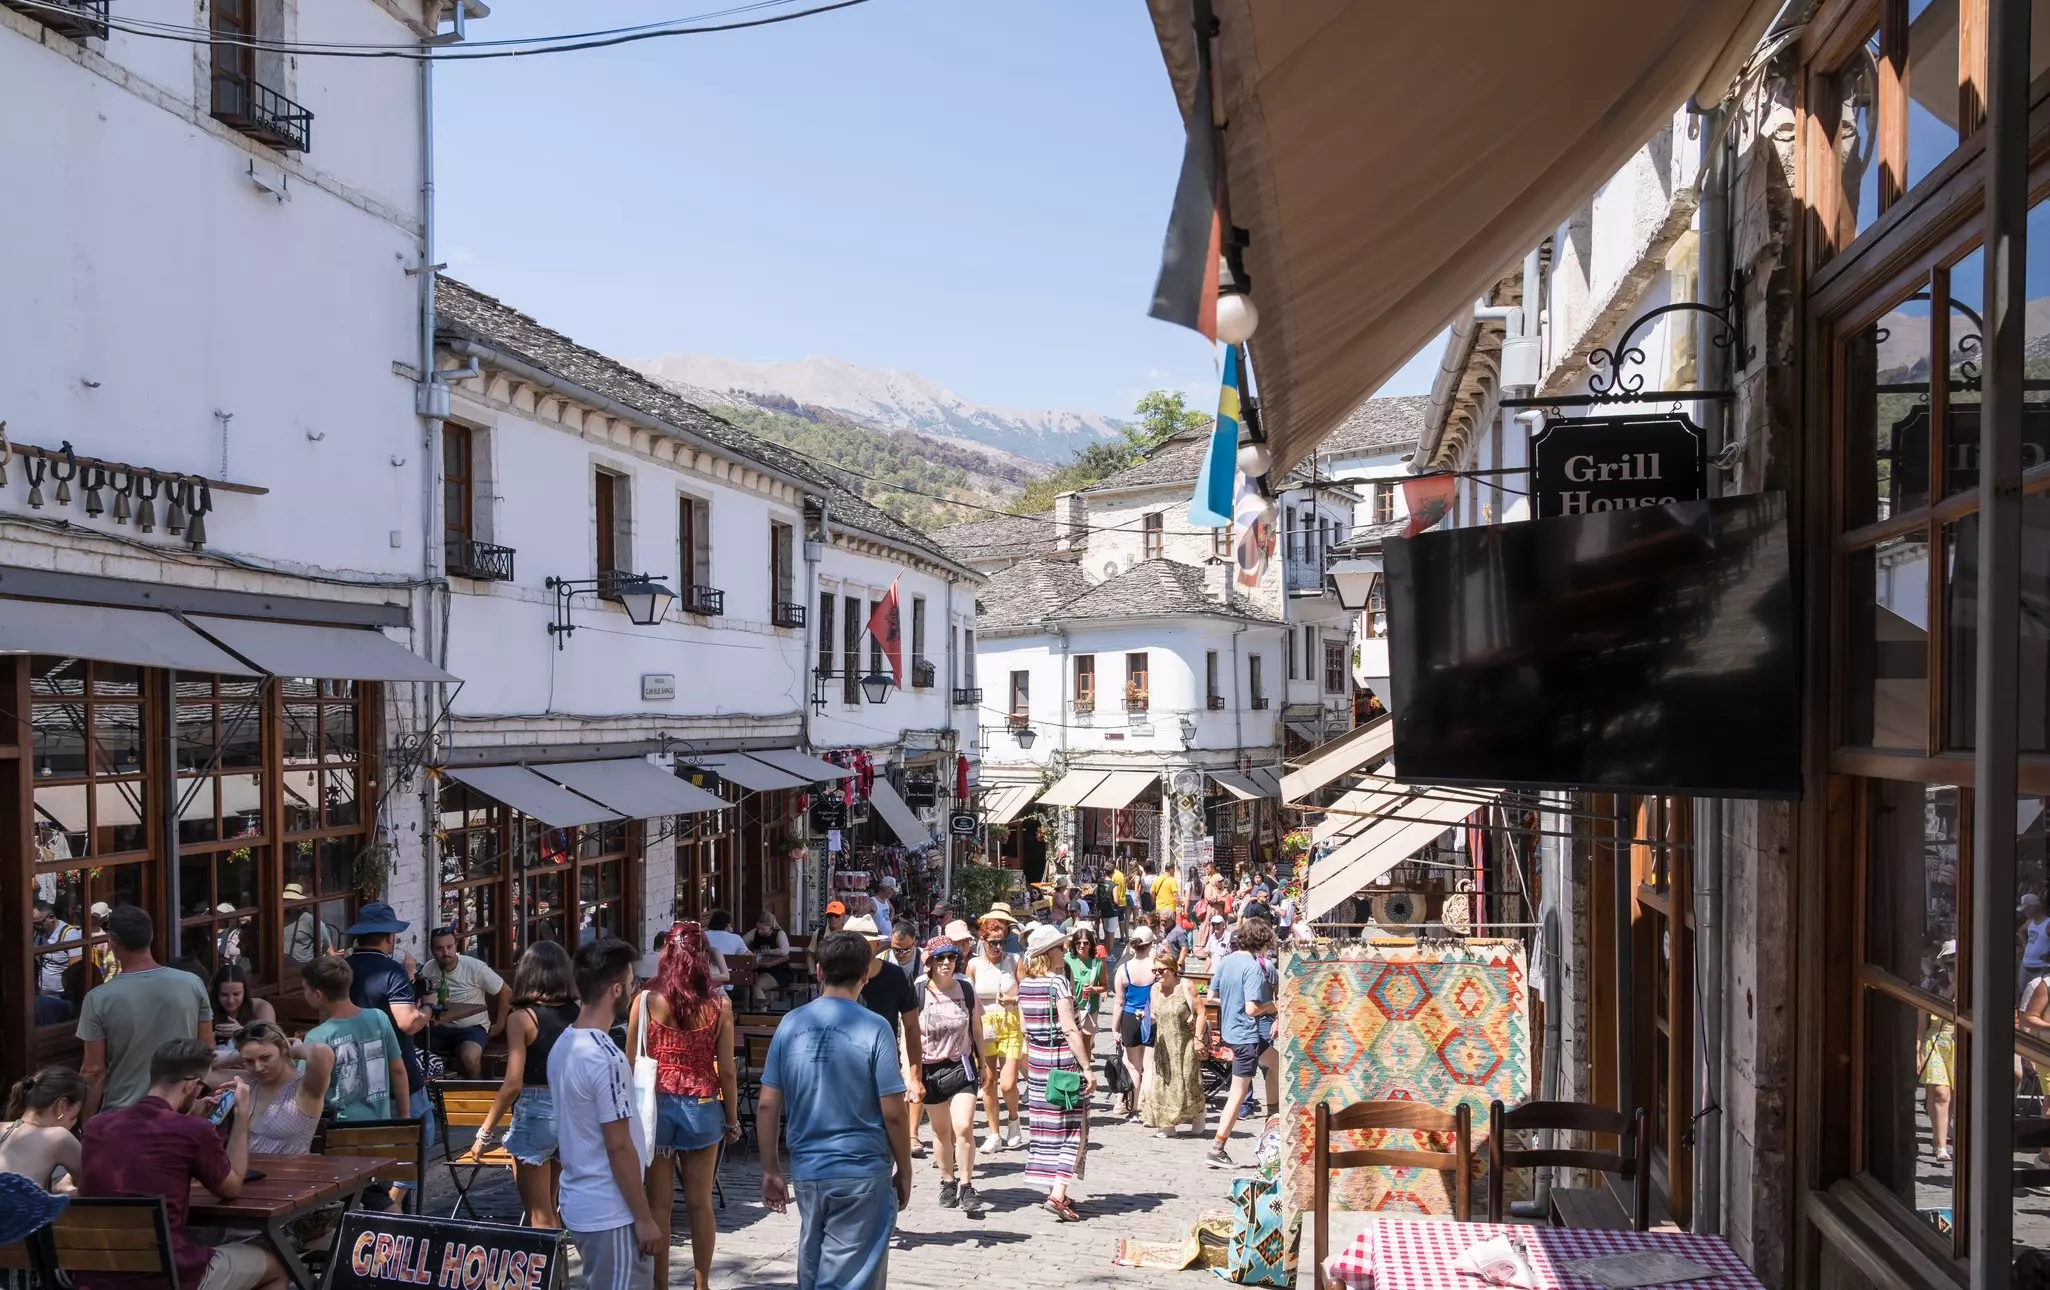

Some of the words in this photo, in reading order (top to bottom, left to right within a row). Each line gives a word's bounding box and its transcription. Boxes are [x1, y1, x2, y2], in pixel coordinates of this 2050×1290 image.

[1564, 453, 1662, 482] Grill
[352, 1230, 432, 1285] GRILL
[438, 1241, 547, 1290] HOUSE
